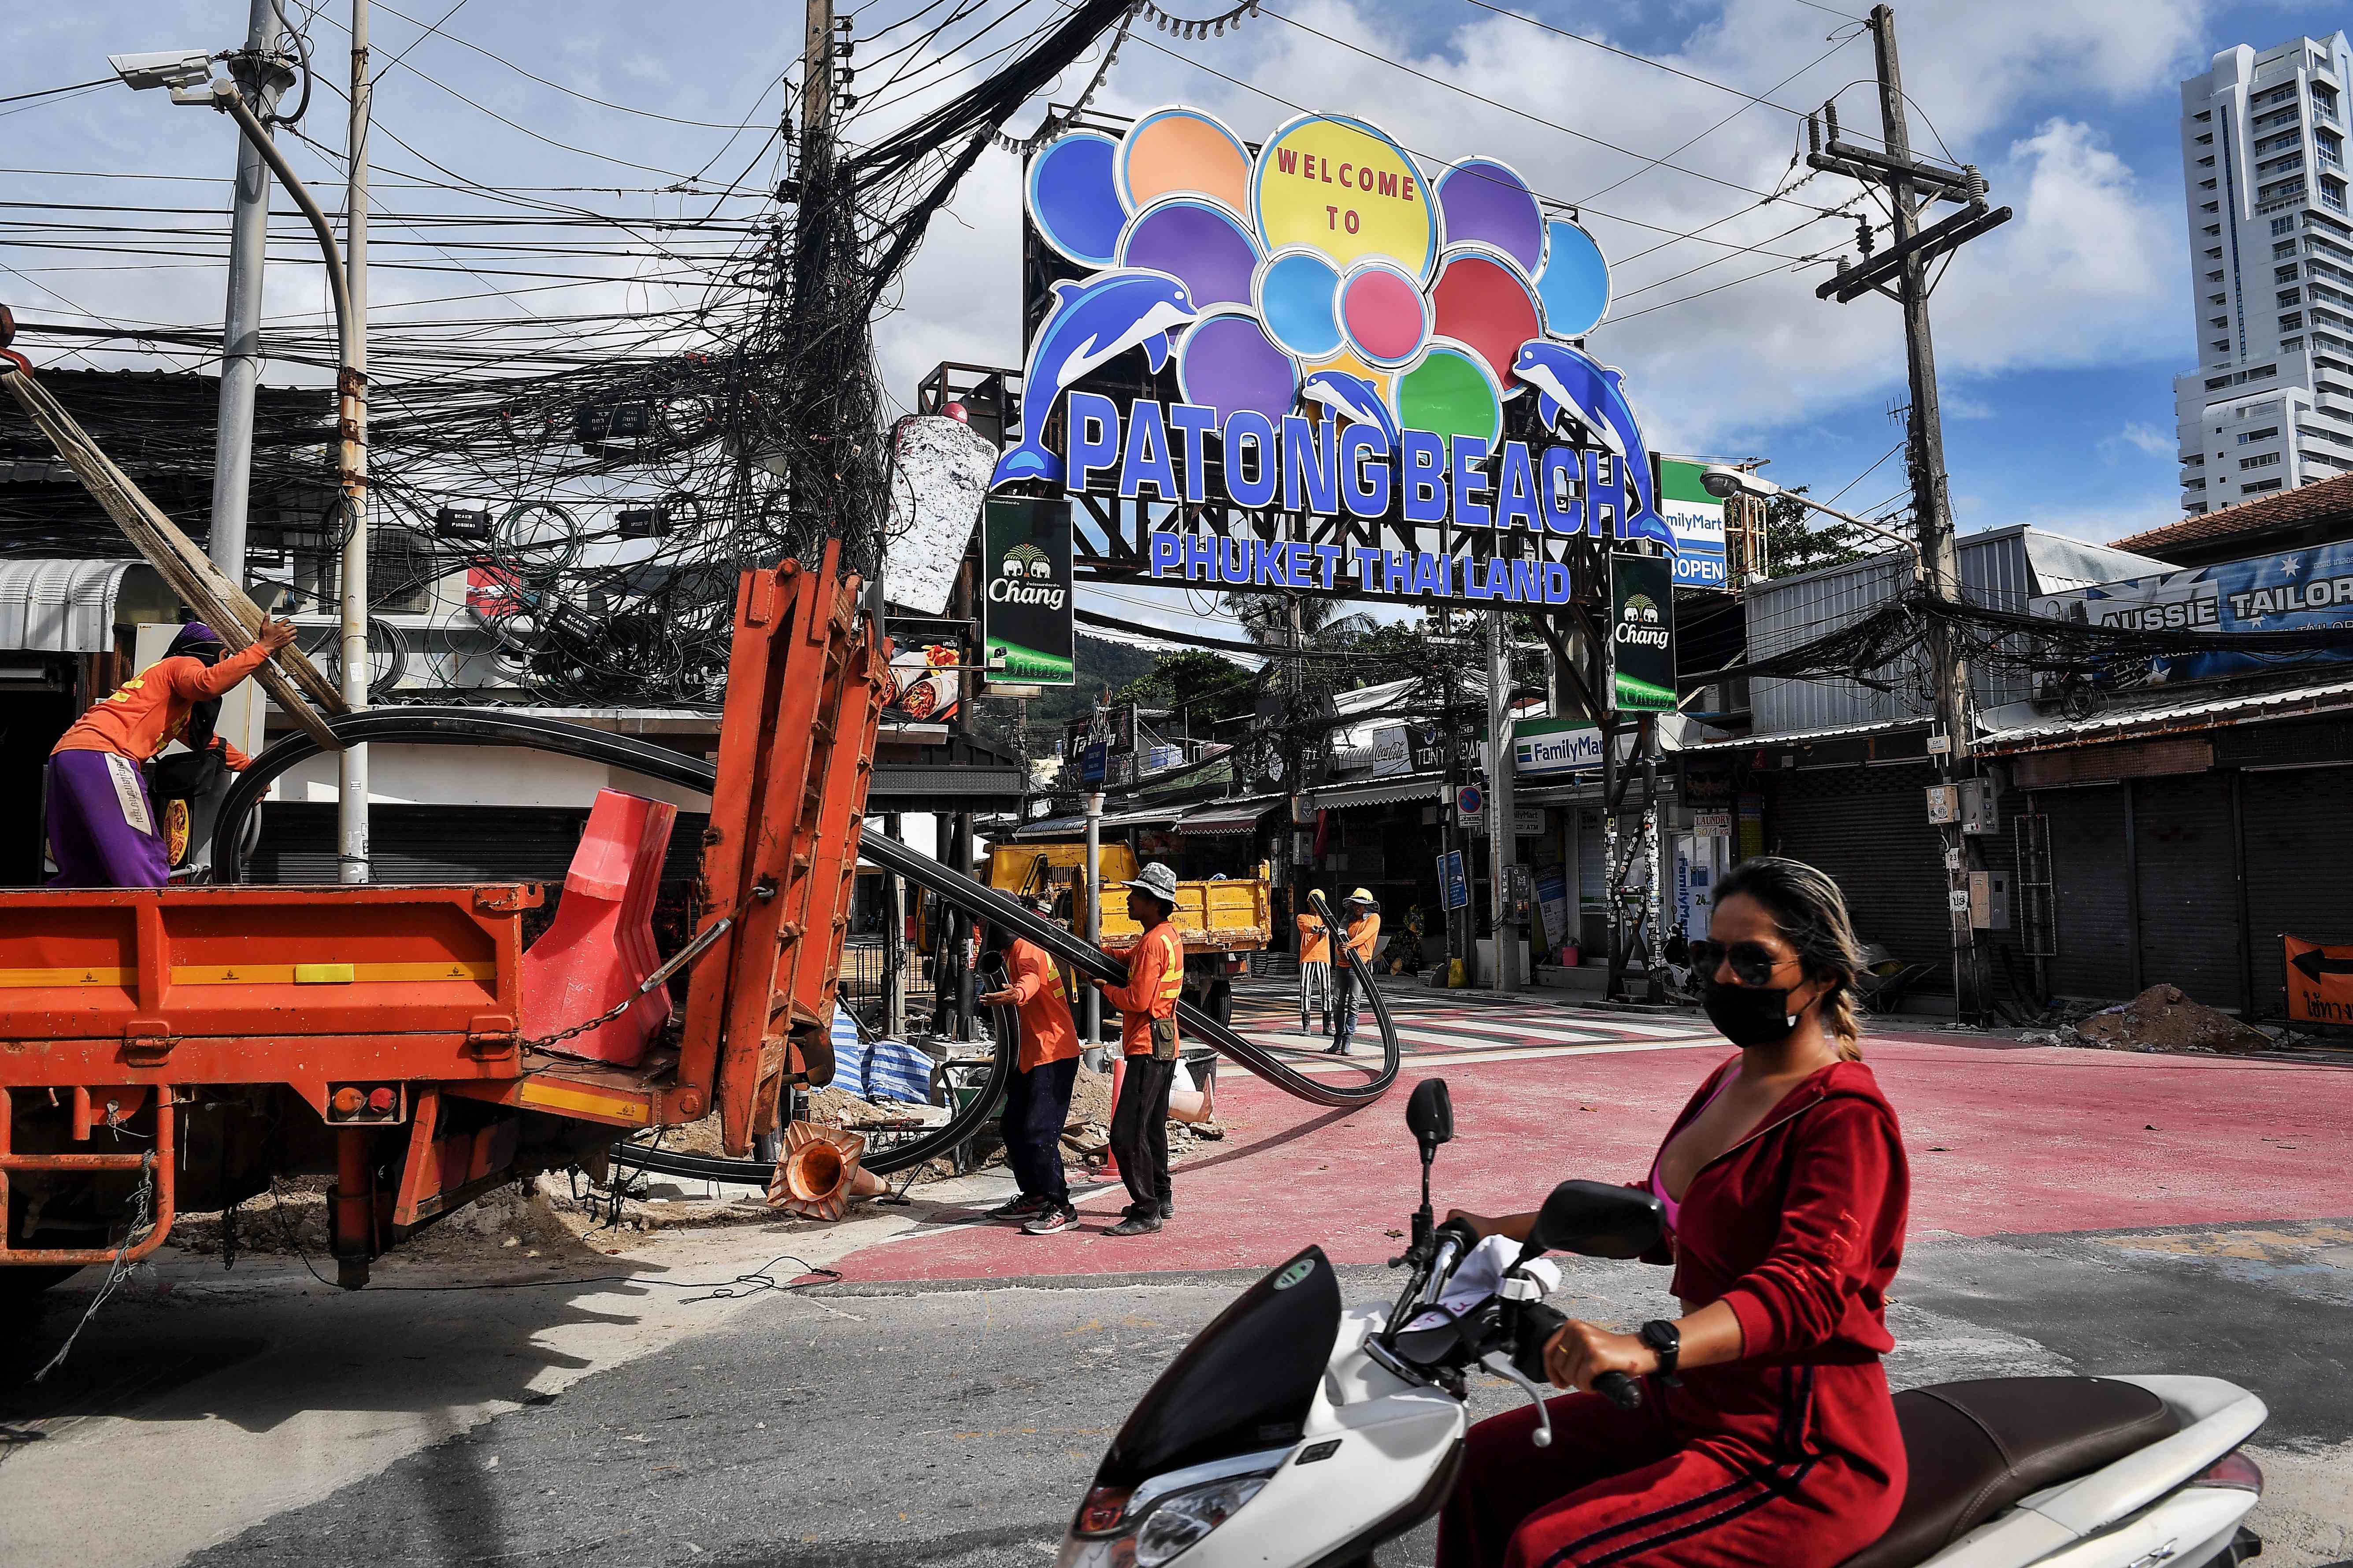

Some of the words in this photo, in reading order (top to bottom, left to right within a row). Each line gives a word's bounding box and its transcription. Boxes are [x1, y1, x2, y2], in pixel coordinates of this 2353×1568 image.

[1278, 148, 1413, 201] WELCOME
[1327, 206, 1359, 234] TO
[1066, 390, 1390, 518] PATONG
[1401, 428, 1628, 540] BEACH
[1664, 513, 1722, 531] milyMart
[1151, 531, 1341, 591] PHUKET
[989, 578, 1066, 610] Chang
[2100, 596, 2217, 631] AUSSIE
[1616, 622, 1669, 650] Chang
[1696, 816, 1730, 825] LAUNDRY
